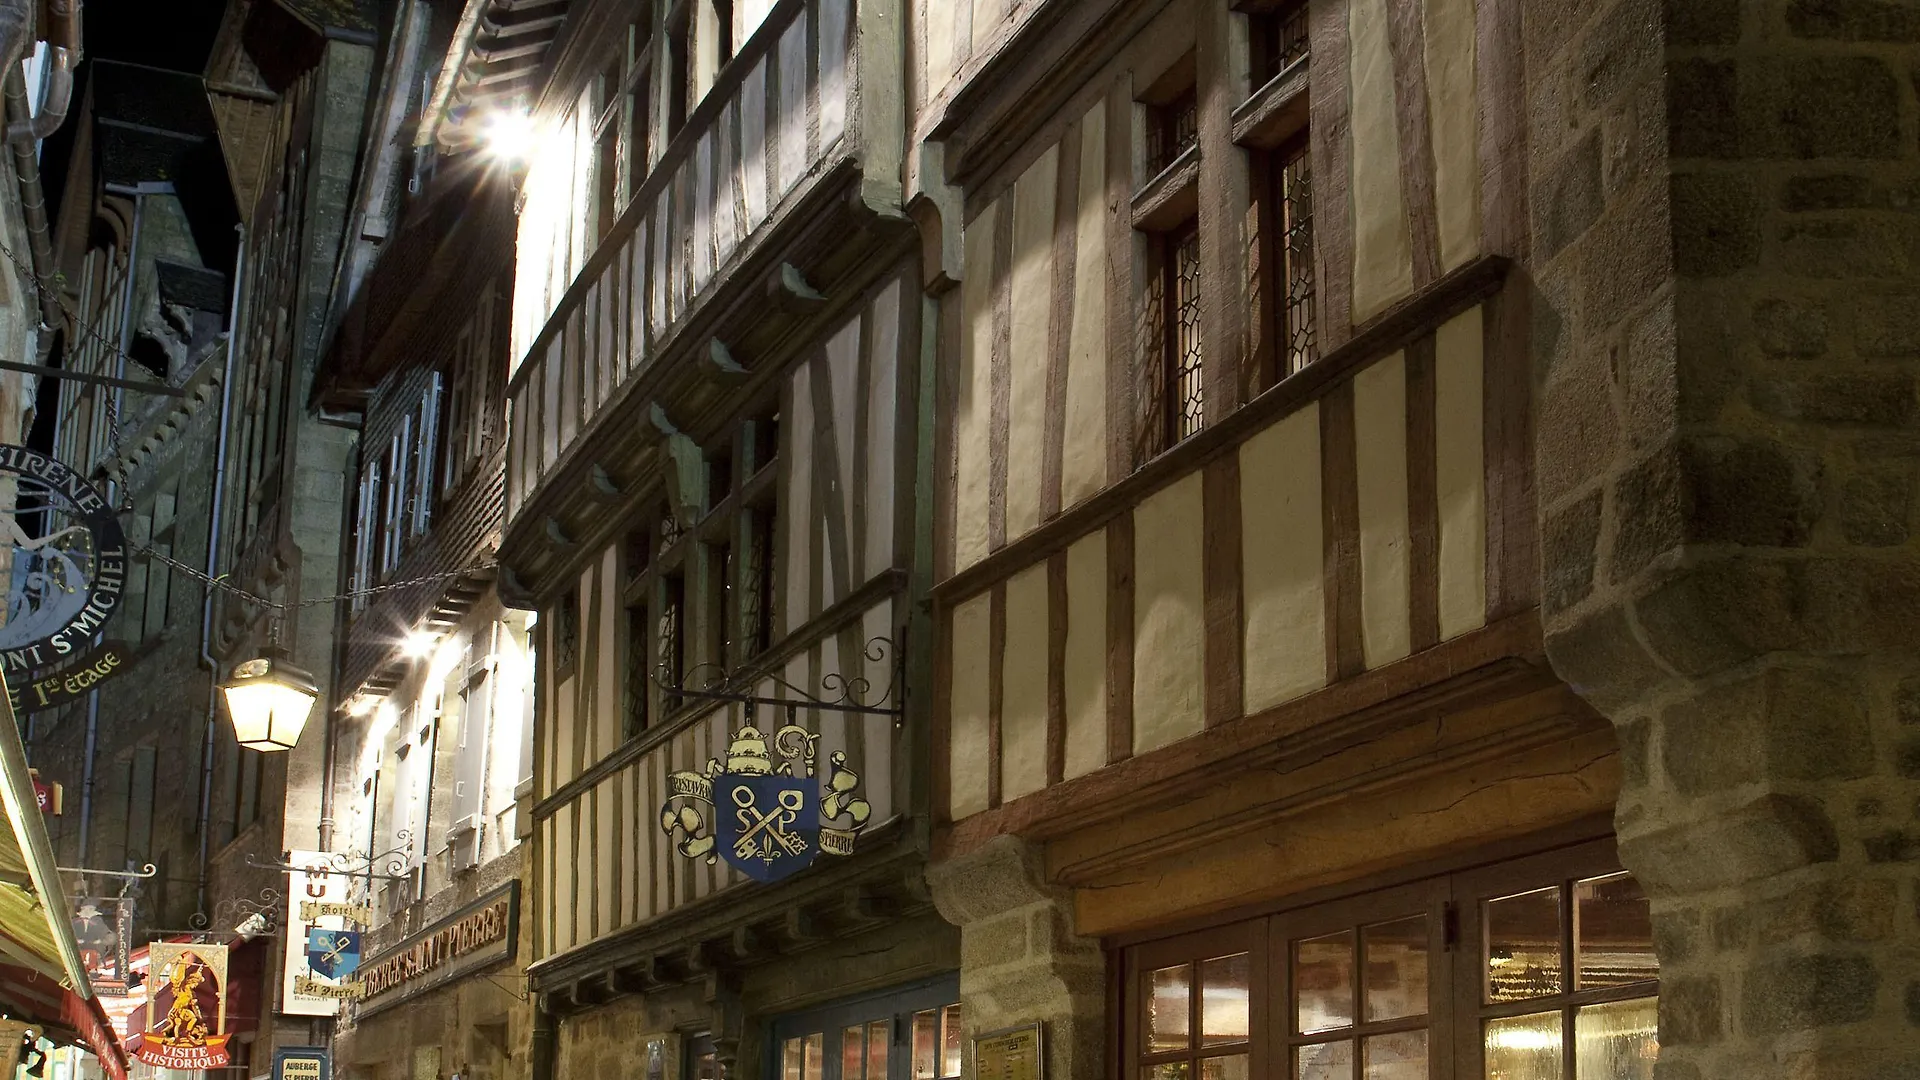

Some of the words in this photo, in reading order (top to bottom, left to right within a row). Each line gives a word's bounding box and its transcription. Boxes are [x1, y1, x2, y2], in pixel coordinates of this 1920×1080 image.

[72, 545, 123, 638] MICHEL
[405, 932, 447, 978] SAINT
[448, 901, 508, 959] PIERRE
[142, 1051, 227, 1070] HISTORIQUE
[162, 1044, 210, 1059] VISITE
[285, 1062, 318, 1071] AUBERGE
